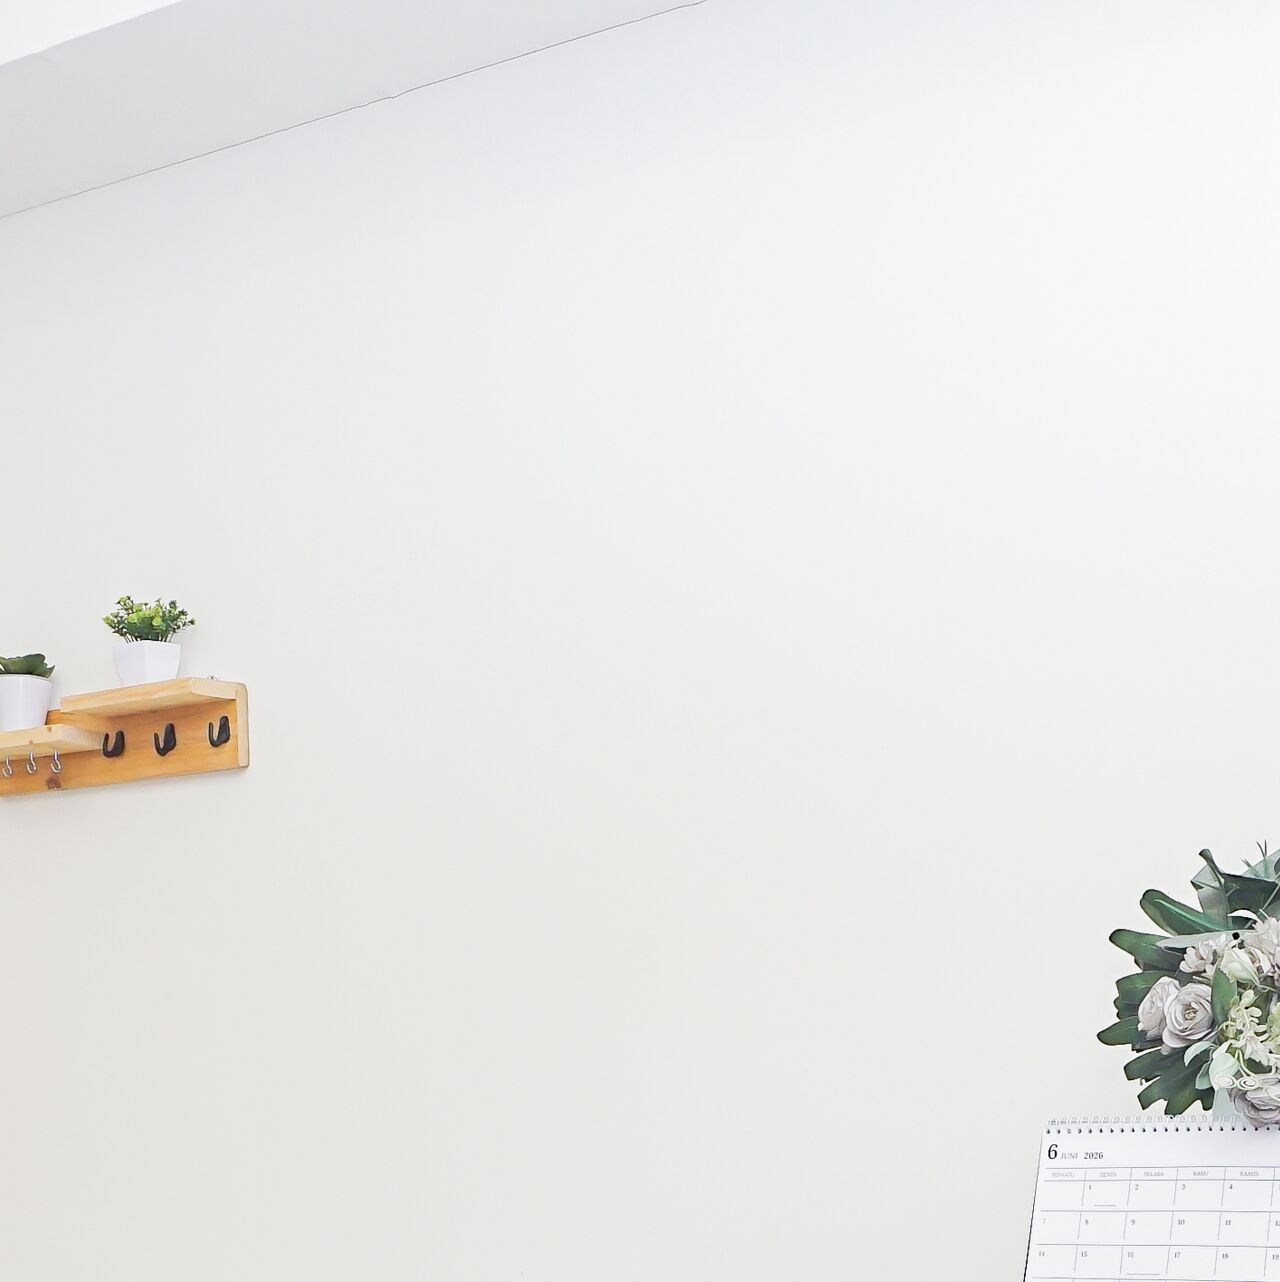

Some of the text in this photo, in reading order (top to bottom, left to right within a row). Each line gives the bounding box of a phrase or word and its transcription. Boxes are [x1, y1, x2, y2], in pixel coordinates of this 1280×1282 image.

[1047, 1143, 1104, 1160] 6 JUNI 2026
[1134, 1183, 1140, 1191] 2
[1181, 1183, 1186, 1191] 3
[1084, 1218, 1089, 1226] 8
[1130, 1218, 1136, 1226] 9
[1177, 1218, 1186, 1226] 10
[1224, 1219, 1232, 1227] 11
[1080, 1250, 1088, 1258] 15
[1127, 1251, 1135, 1259] 16
[1174, 1251, 1181, 1259] 17
[1221, 1252, 1229, 1260] 18
[1271, 1253, 1280, 1261] 19
